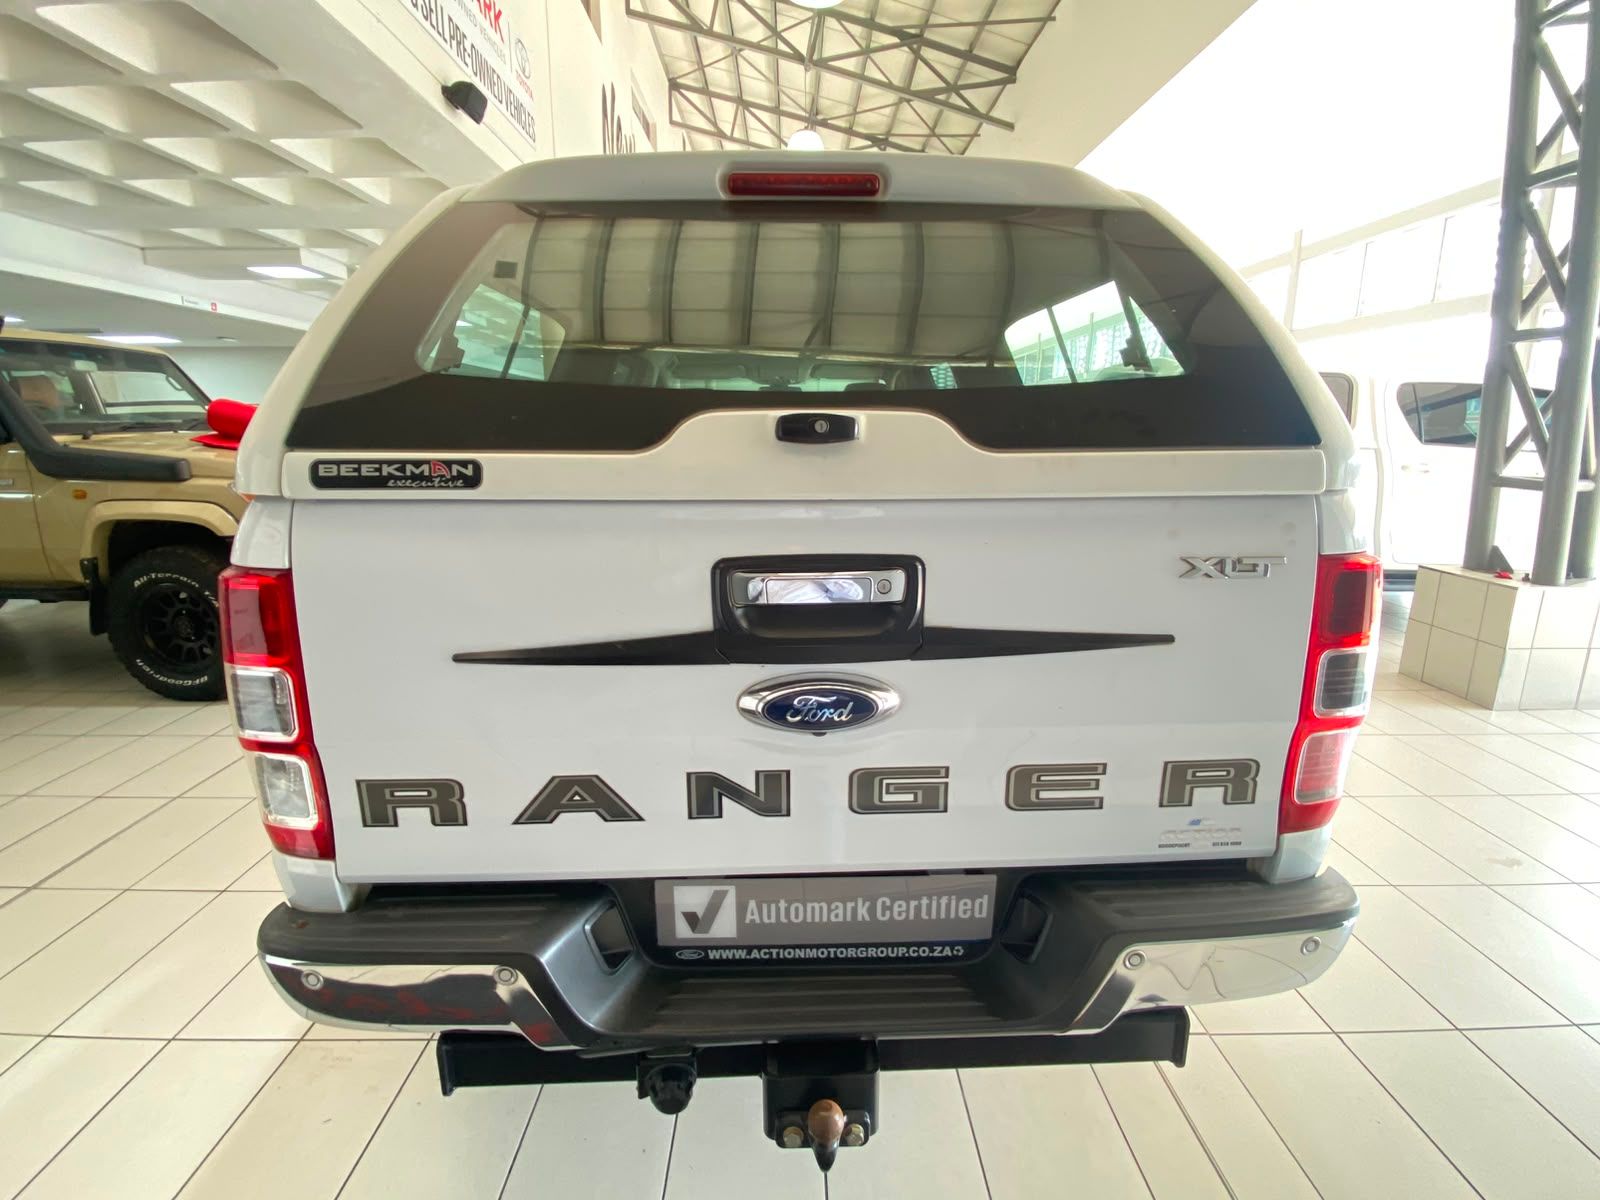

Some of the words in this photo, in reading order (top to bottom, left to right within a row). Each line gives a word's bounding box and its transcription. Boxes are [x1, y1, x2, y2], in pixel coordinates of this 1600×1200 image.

[447, 14, 504, 105] PRE-OWNED
[502, 79, 536, 143] VEHICLES
[515, 69, 535, 102] TOYOTA
[317, 460, 474, 478] BEEKMAN
[386, 476, 465, 488] executive
[1178, 556, 1288, 579] XLT
[786, 695, 854, 723] Ford
[355, 758, 1261, 828] RANGER
[744, 898, 871, 925] Automark
[876, 894, 989, 921] Certified
[707, 946, 953, 960] WWW.ACTIONMOTORGROUP.CO.ZA
